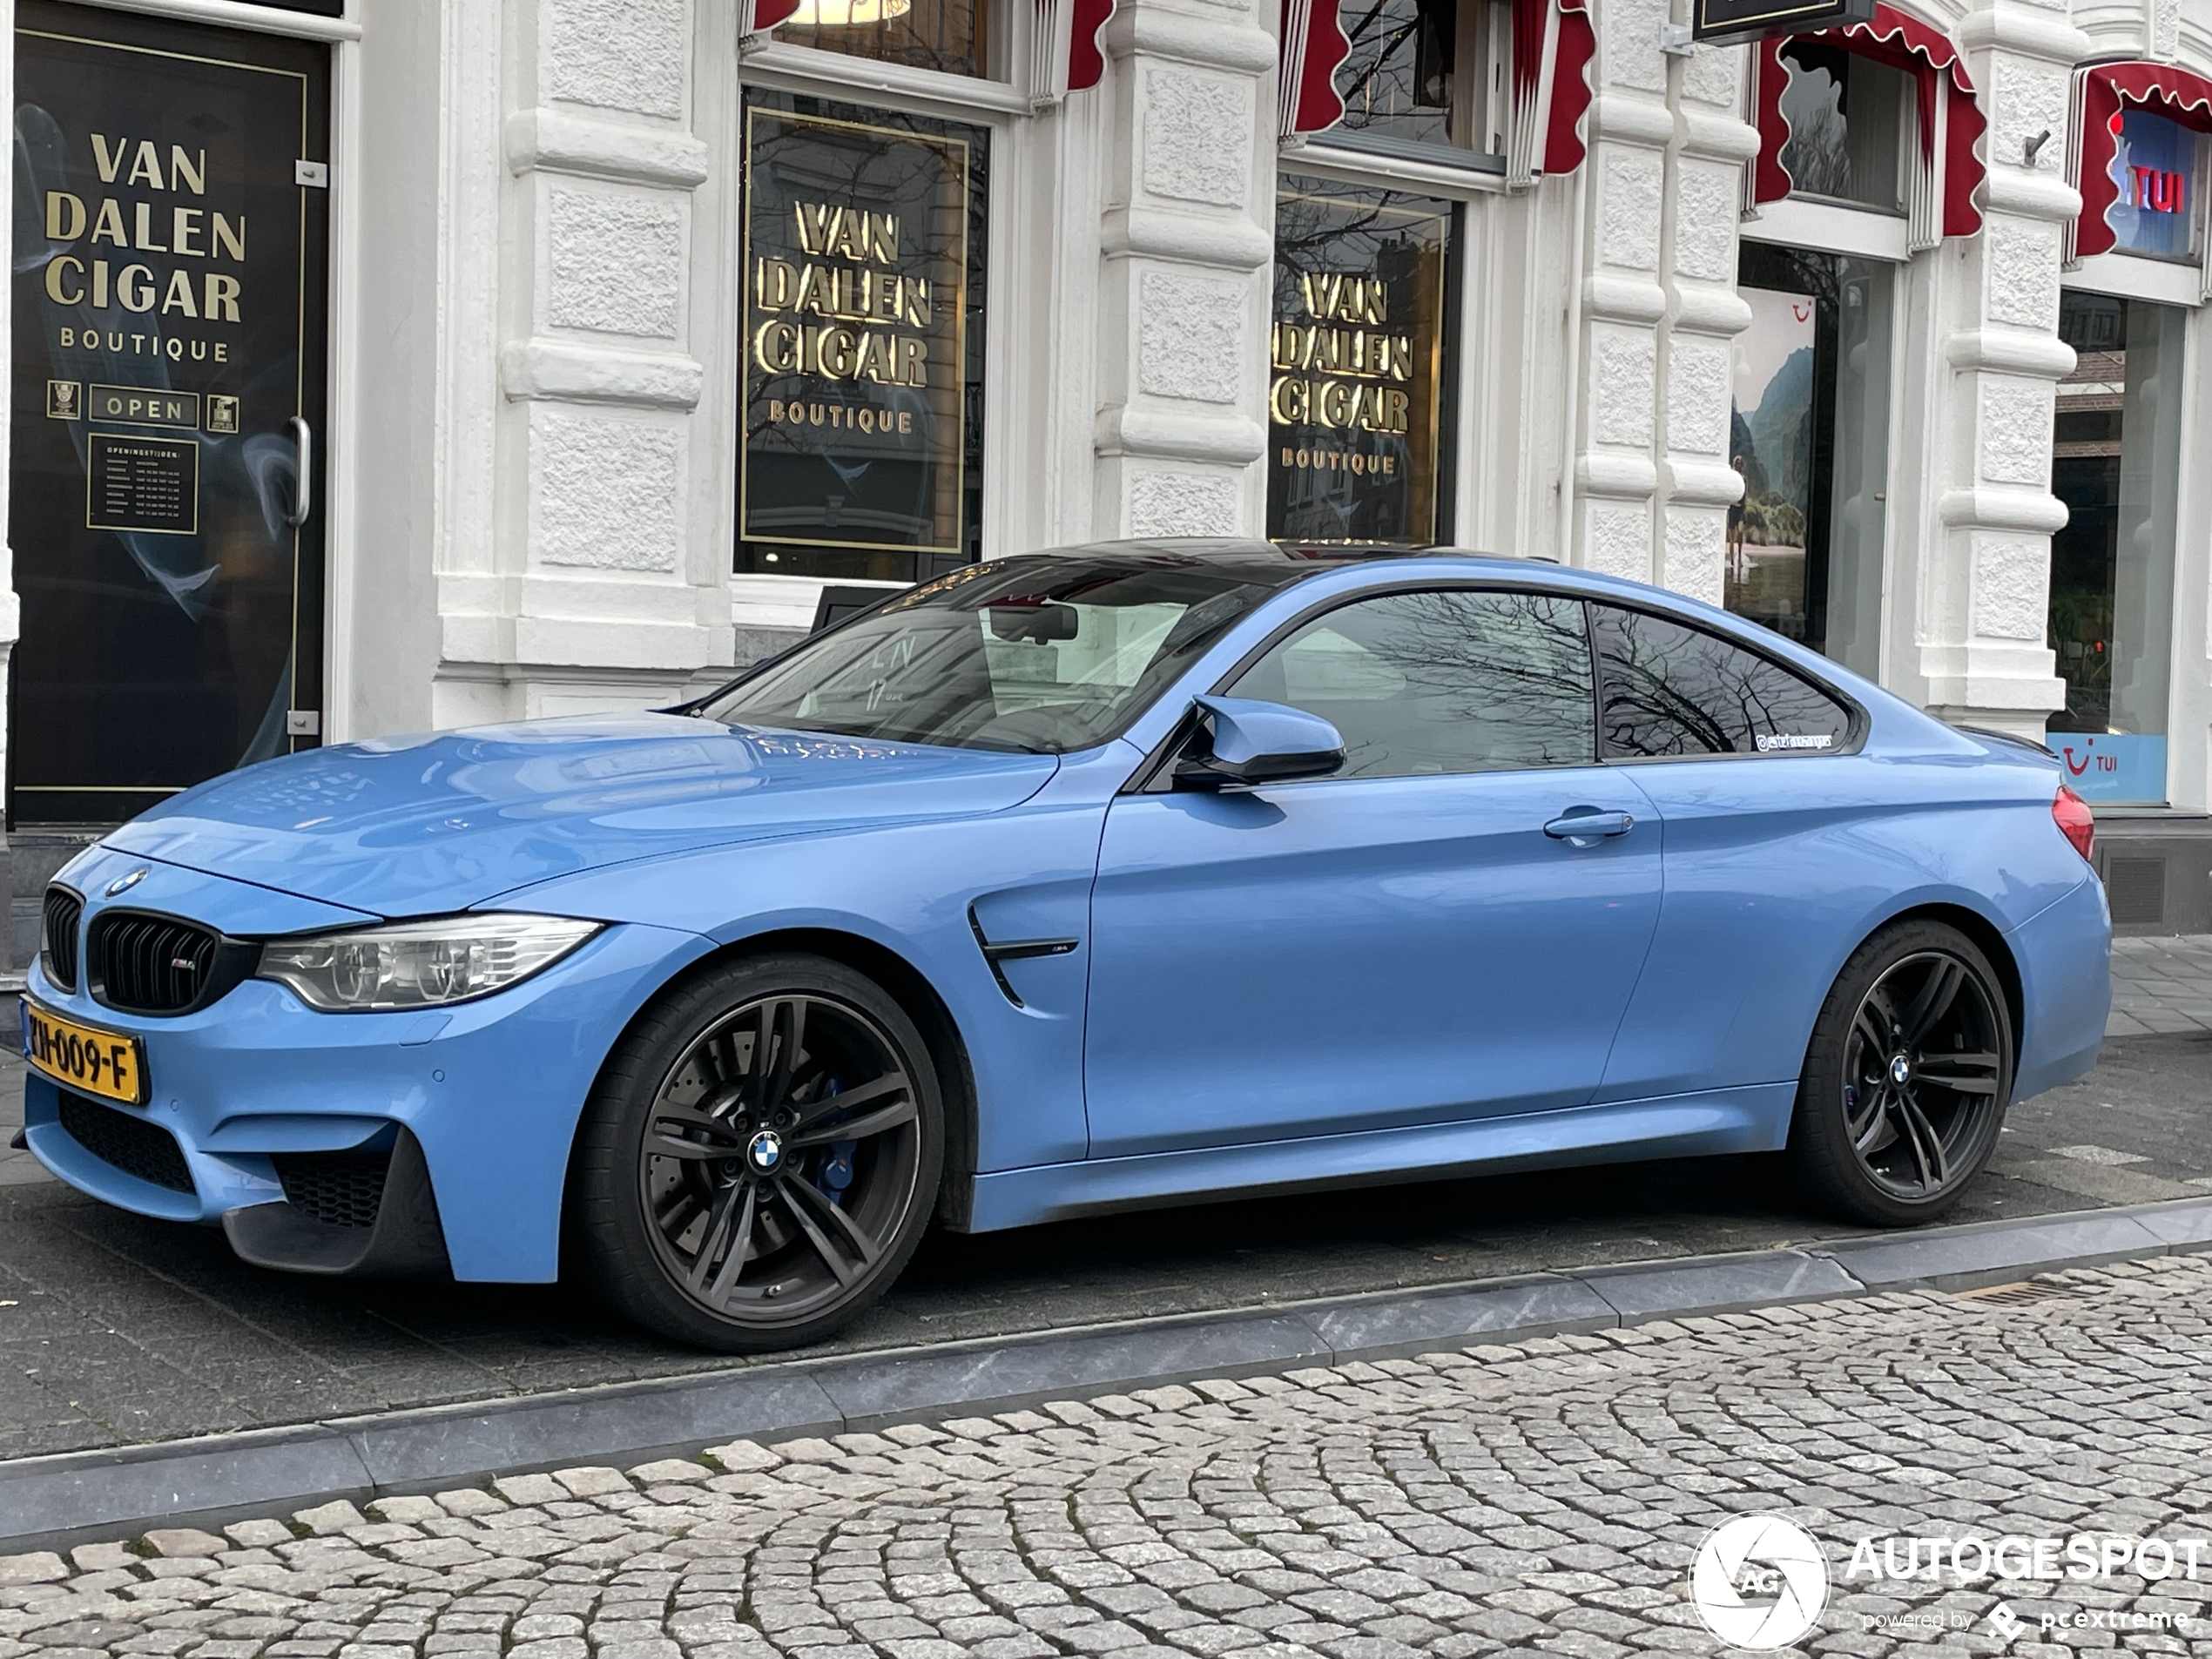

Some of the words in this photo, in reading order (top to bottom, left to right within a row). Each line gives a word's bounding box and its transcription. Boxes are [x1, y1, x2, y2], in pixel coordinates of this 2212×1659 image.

[91, 133, 206, 195] VAN
[2126, 165, 2184, 214] TUI
[46, 191, 246, 261] DALEN
[795, 201, 900, 264] VAN
[45, 255, 241, 323] CIGAR
[758, 257, 932, 327] DALEN
[1304, 271, 1388, 326] VAN
[60, 327, 228, 362] BOUTIQUE
[754, 320, 928, 388] CIGAR
[1272, 321, 1414, 381] DALEN
[106, 397, 182, 420] OPEN
[770, 400, 913, 435] BOUTIQUE
[1270, 376, 1409, 435] CIGAR
[1282, 447, 1395, 476] BOUTIQUE
[2096, 756, 2118, 772] TUI
